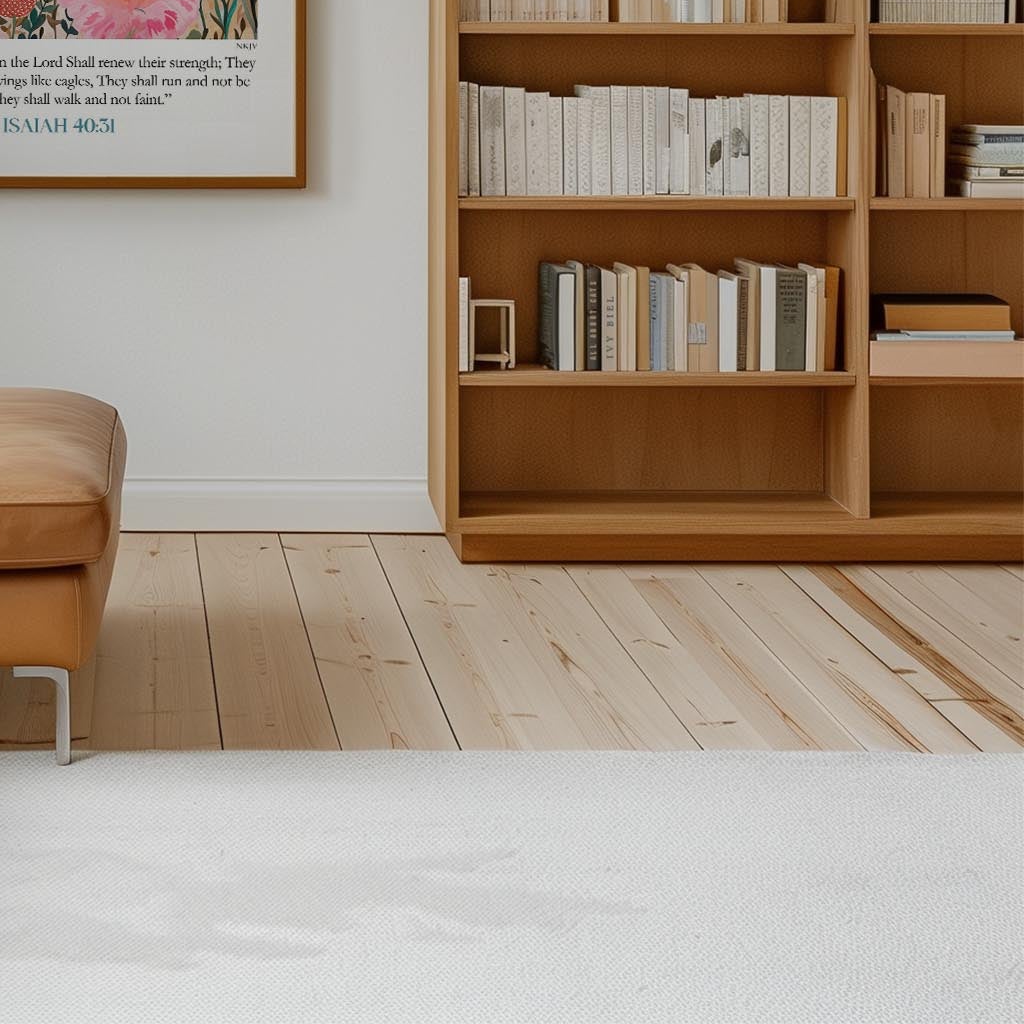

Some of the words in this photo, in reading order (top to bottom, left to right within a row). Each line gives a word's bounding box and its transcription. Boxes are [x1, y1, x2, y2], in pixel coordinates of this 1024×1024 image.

[11, 56, 29, 68] the
[33, 56, 63, 68] Lord
[66, 56, 95, 68] Shall
[98, 59, 134, 68] renew
[138, 56, 166, 68] their
[169, 56, 221, 72] strength;
[225, 56, 256, 72] They
[31, 75, 51, 86] like
[54, 75, 93, 90] eagles,
[96, 75, 128, 90] They
[131, 75, 157, 87] shall
[161, 78, 181, 87] run
[185, 75, 207, 87] and
[211, 78, 232, 87] not
[236, 75, 251, 87] be
[24, 93, 50, 105] shall
[54, 93, 82, 105] walk
[85, 93, 107, 105] and
[111, 95, 131, 105] not
[134, 93, 173, 105] faint.”
[3, 118, 68, 134] ISAIAH
[72, 118, 115, 134] 40:31
[606, 296, 615, 327] BIEL
[590, 343, 598, 361] ALL
[606, 336, 614, 359] IVY
